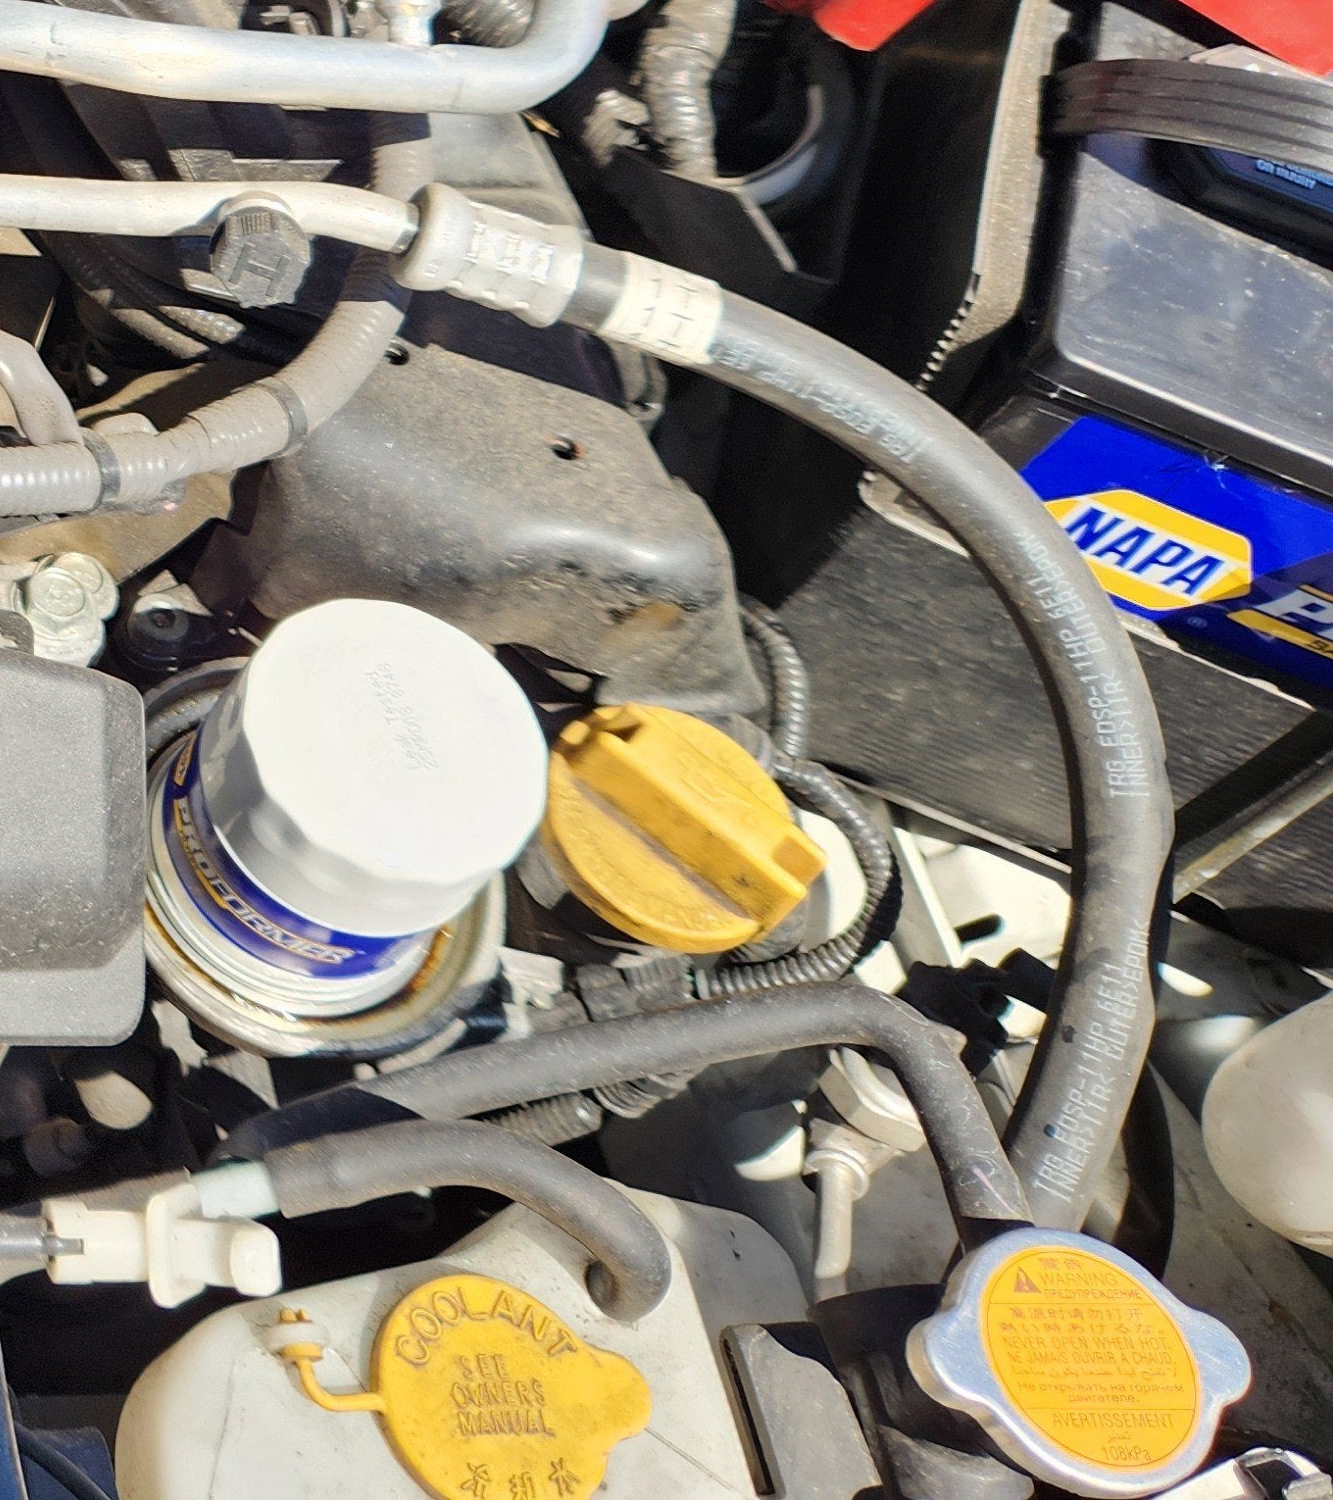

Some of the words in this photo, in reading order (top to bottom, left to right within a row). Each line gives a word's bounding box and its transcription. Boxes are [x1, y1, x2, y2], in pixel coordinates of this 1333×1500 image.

[1064, 506, 1226, 595] NAPA
[1039, 1272, 1119, 1288] WARNING
[396, 1286, 578, 1368] COOLANT
[1002, 1336, 1046, 1350] NEVER
[1051, 1336, 1088, 1350] OPEN
[1091, 1336, 1134, 1350] WHEN
[455, 1353, 509, 1380] SEE
[1007, 1352, 1023, 1365] NE
[1026, 1352, 1070, 1365] JAMAIS
[1072, 1352, 1118, 1365] OUVRIR
[451, 1377, 546, 1410] OWNERS
[457, 1408, 557, 1438] MANUAL
[1052, 1412, 1175, 1429] AVERTISSEMENT
[1101, 1445, 1152, 1462] 108kPa
